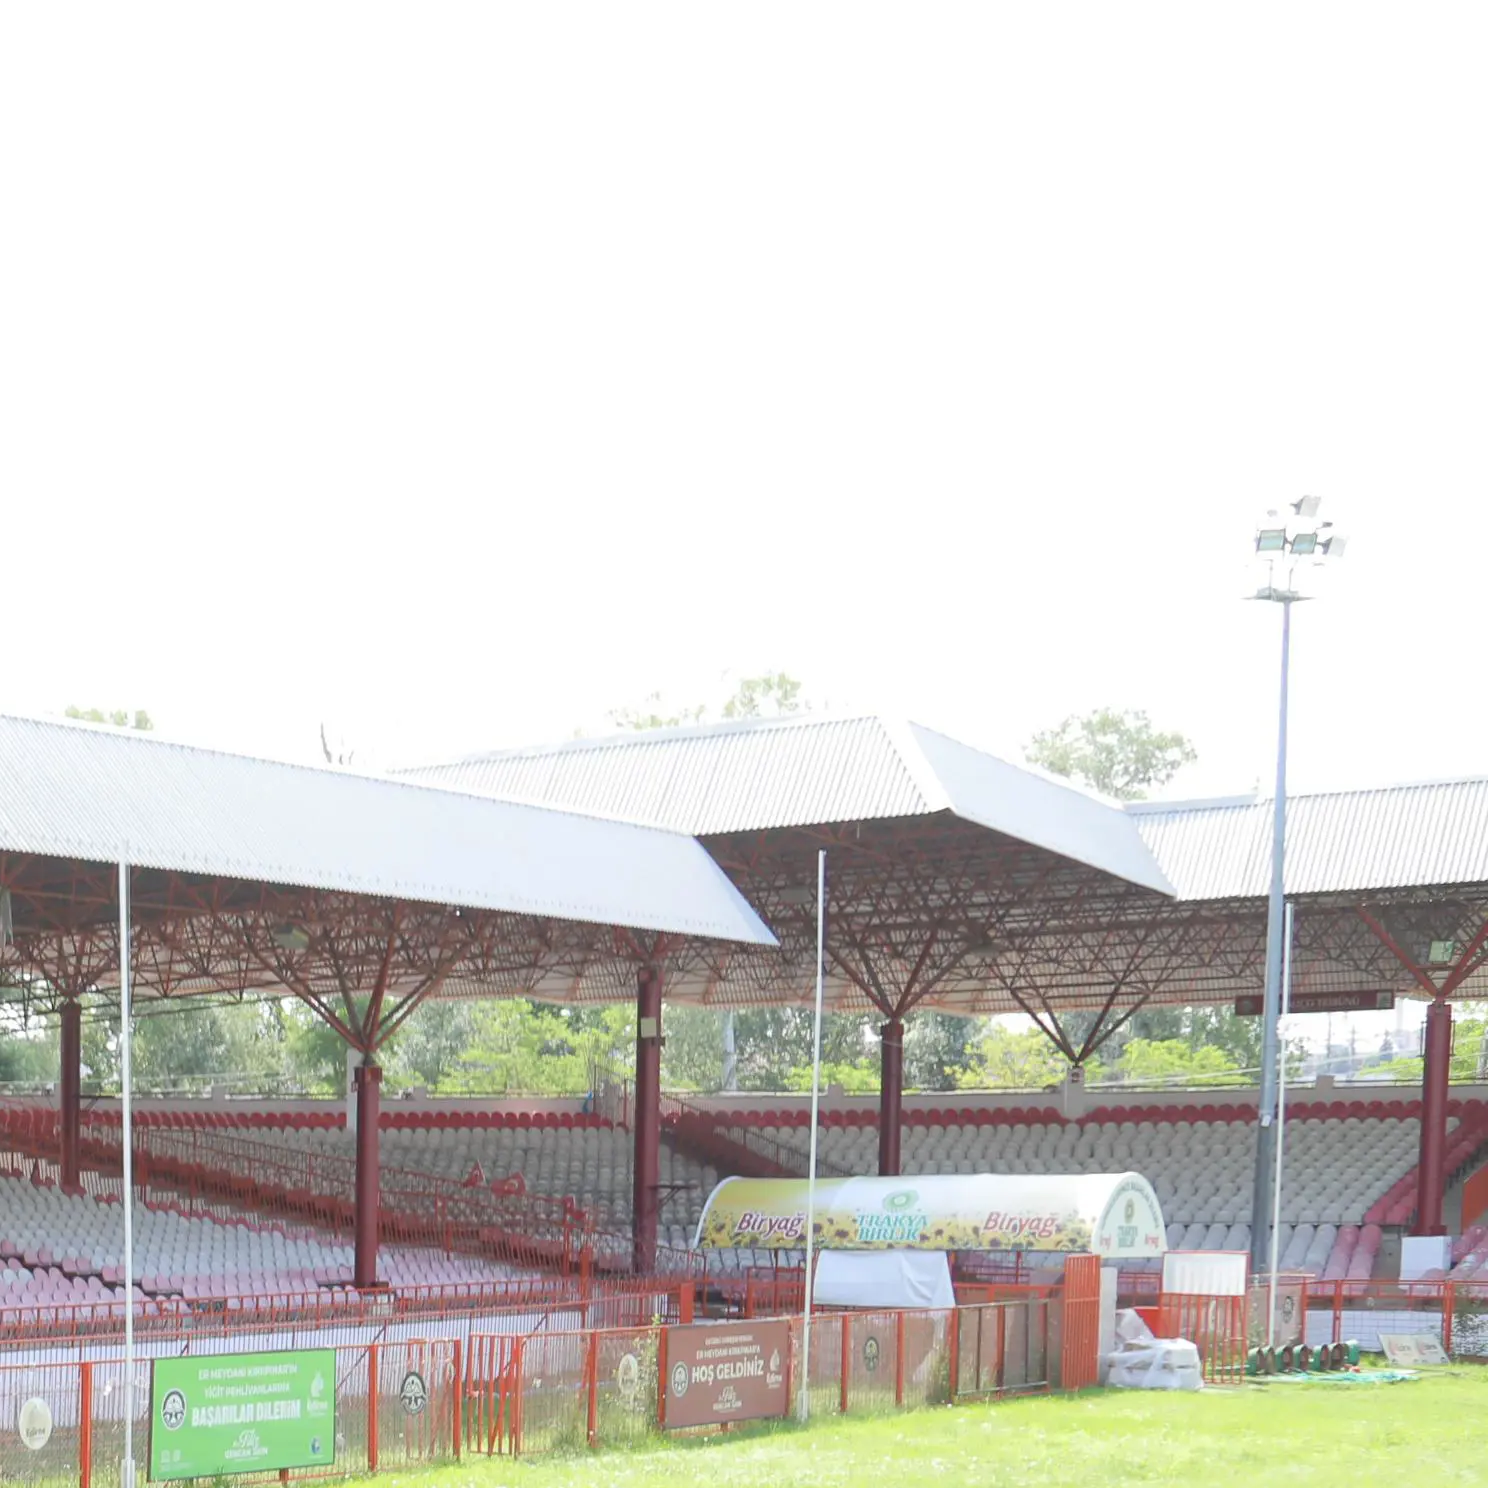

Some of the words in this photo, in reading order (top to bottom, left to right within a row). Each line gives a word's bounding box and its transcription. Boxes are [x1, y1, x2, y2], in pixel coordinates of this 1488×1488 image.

[691, 1364, 714, 1386] HOŞ
[716, 1355, 765, 1379] GELDİNİZ
[192, 1403, 254, 1428] BAŞARILAR
[256, 1399, 302, 1422] DİLERİM
